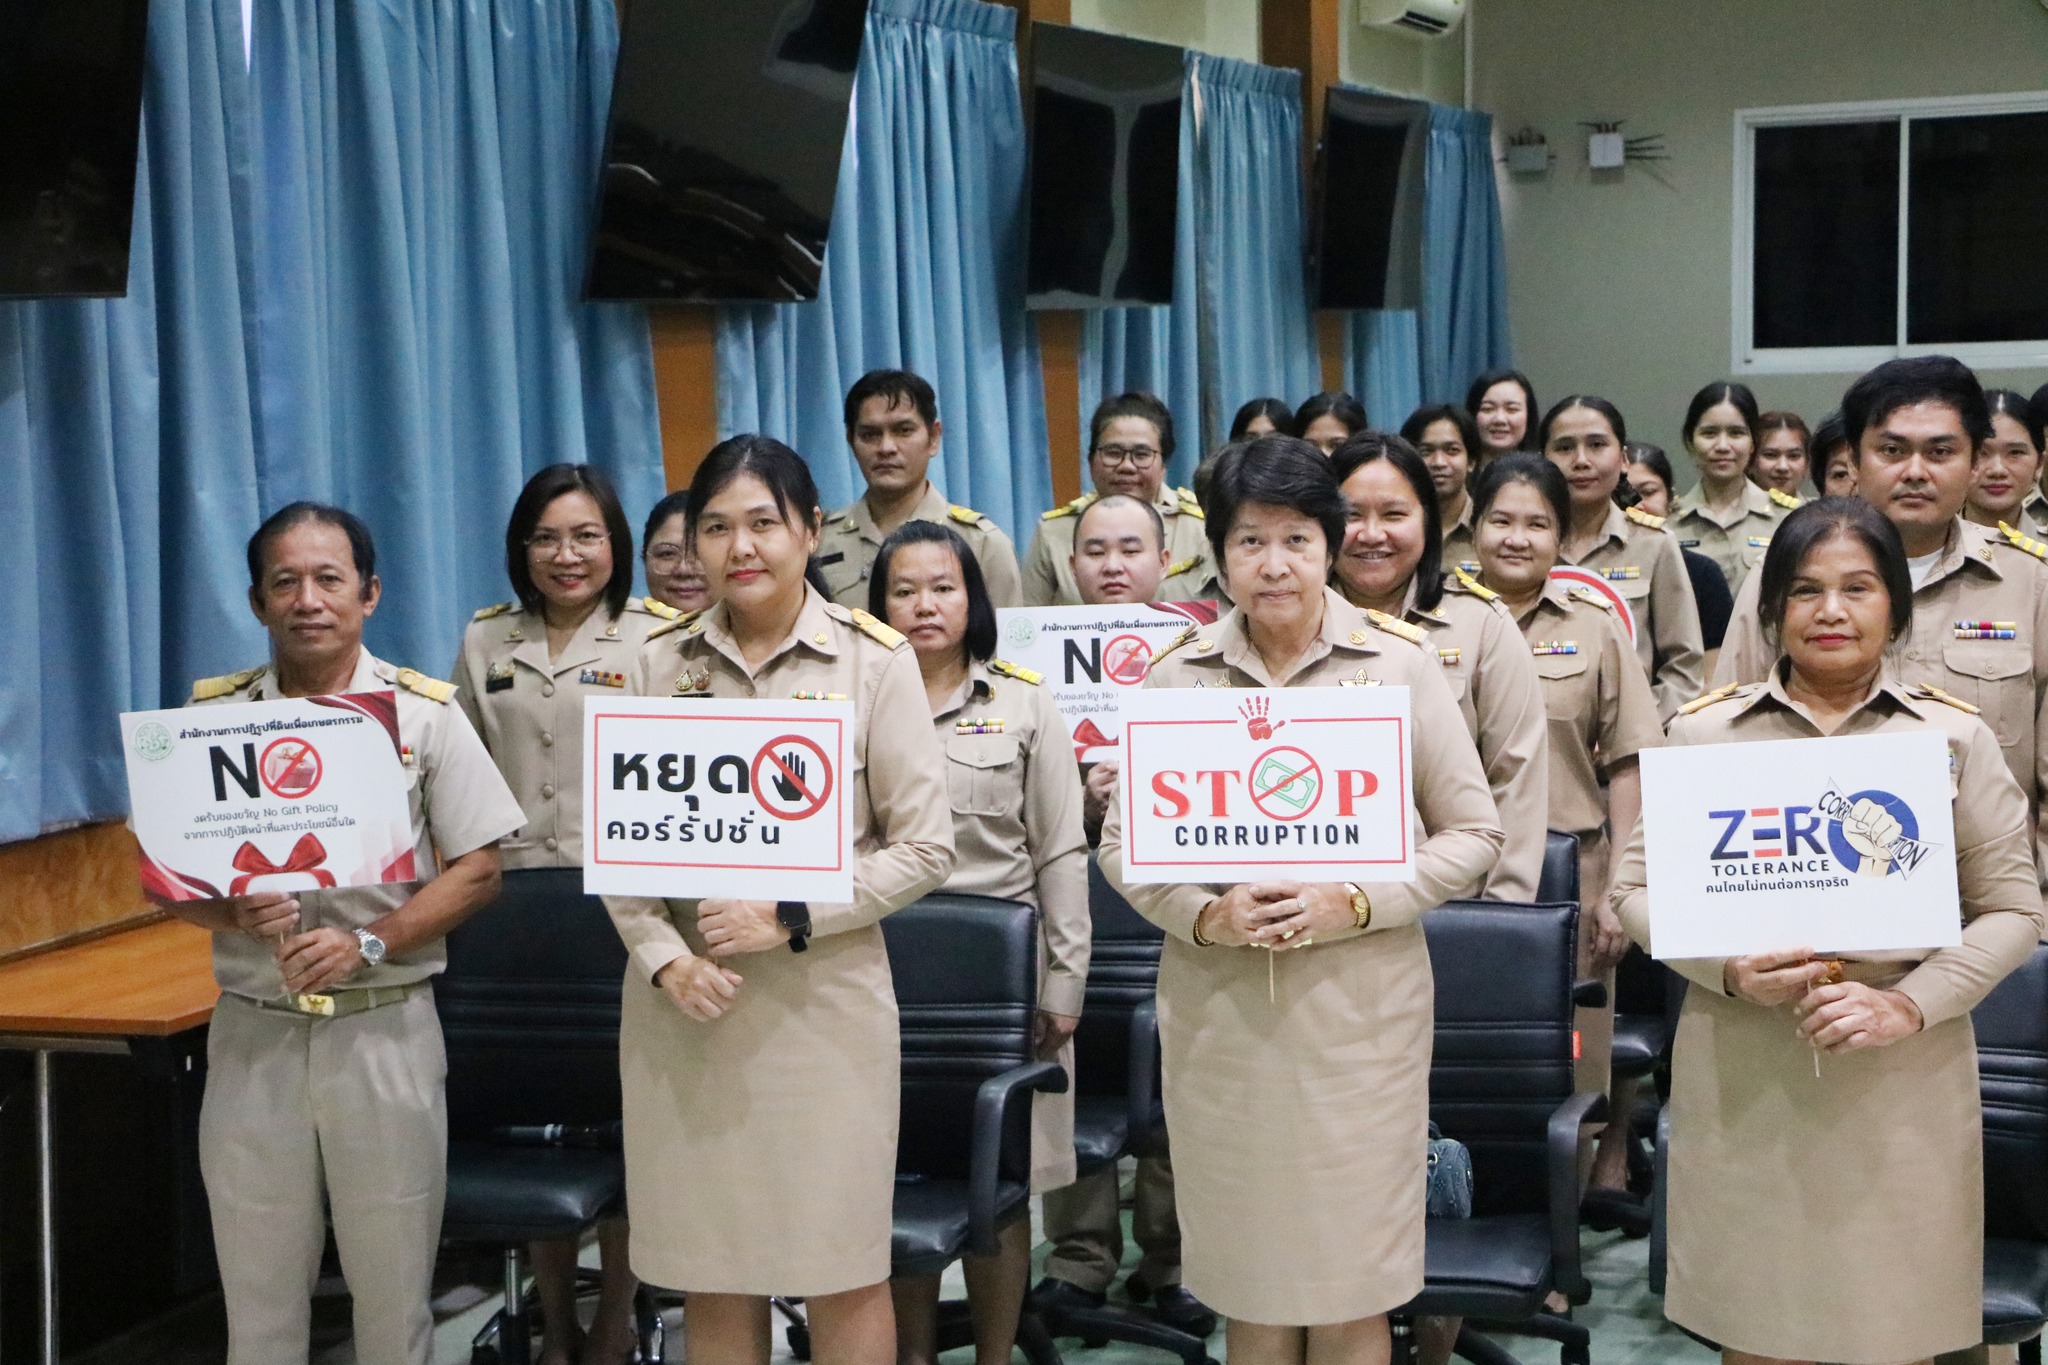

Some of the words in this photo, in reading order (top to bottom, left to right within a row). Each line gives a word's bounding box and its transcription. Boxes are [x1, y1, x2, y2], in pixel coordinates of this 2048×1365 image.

[1042, 619, 1190, 633] สำนักงานการปฏิรูปที่ดินเพื่อเกษตรกรรม
[179, 715, 364, 740] สำนักงานการปฏิรูปที่ดินเพื่อเกษตรกรรม
[613, 752, 750, 812] หยุด
[1151, 745, 1379, 822] STOP
[193, 808, 260, 824] งดรับของขวัญ
[263, 808, 278, 818] No
[281, 804, 301, 816] Gift
[305, 803, 338, 814] Policy
[183, 816, 356, 840] จากการปฏิบัติหน้าที่และประโยชน์อื่นใด
[607, 810, 780, 845] คอร์รัปชั่น
[1175, 824, 1360, 846] CORRUPTION
[1712, 859, 1830, 877] TOLERANCE
[1706, 876, 1849, 893] คนไทยไม่ทนต่อการทุจริต
